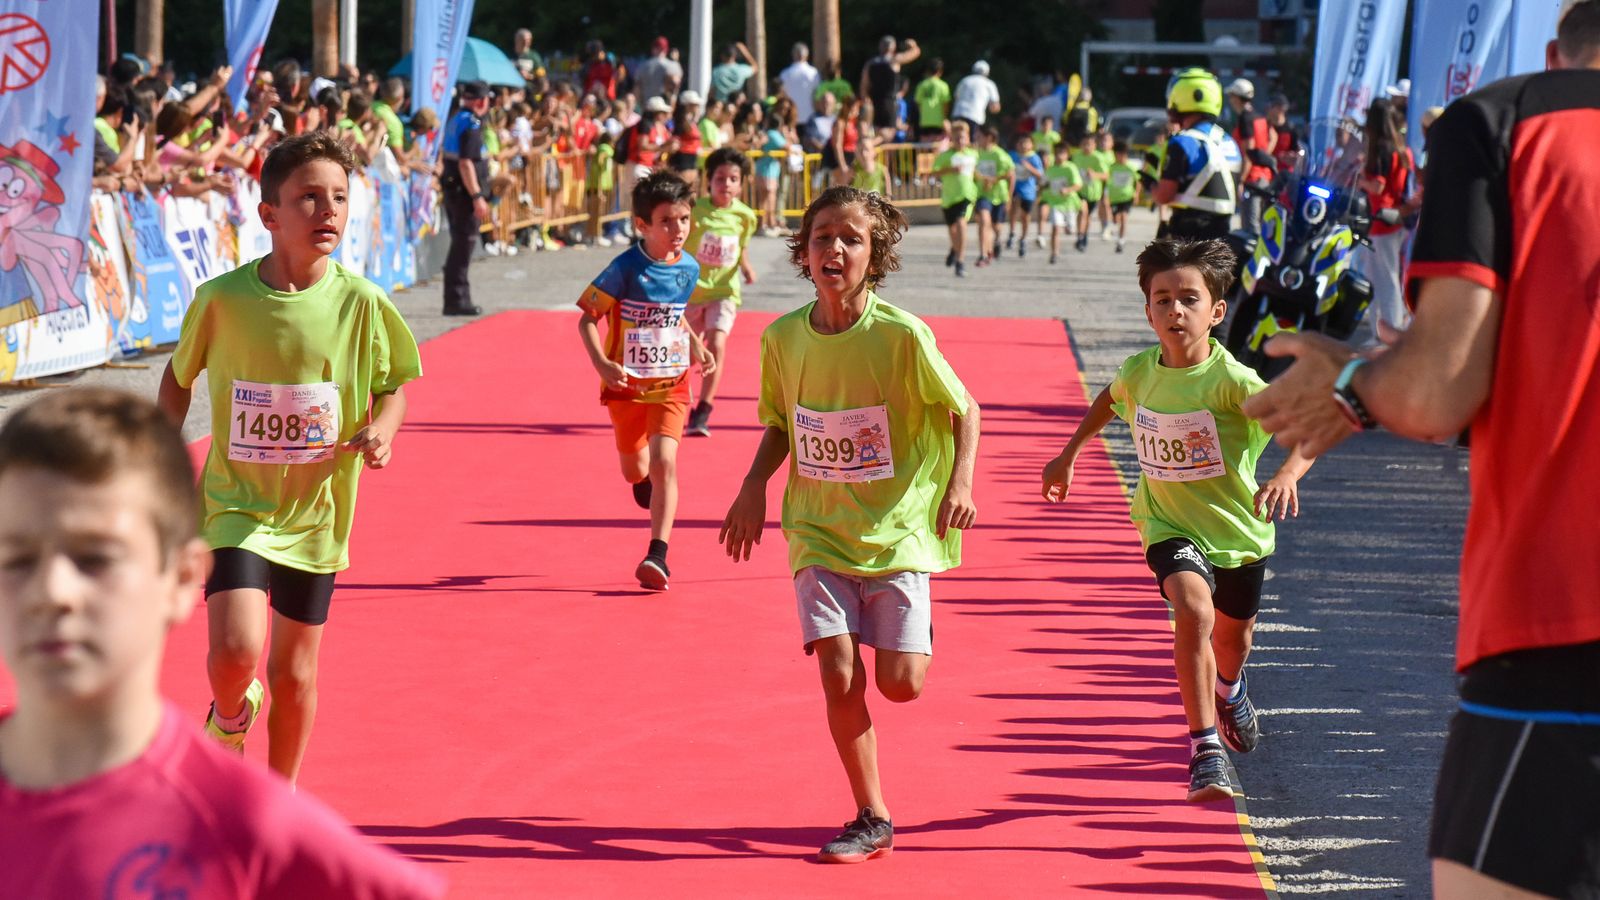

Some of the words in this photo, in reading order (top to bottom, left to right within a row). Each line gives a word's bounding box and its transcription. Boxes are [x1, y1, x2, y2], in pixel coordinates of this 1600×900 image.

[1348, 0, 1376, 78] Serg
[629, 346, 668, 364] 1533
[235, 387, 252, 402] XXI
[236, 410, 301, 442] 1498
[796, 412, 809, 427] XXI
[842, 413, 866, 422] JAVIER
[799, 433, 855, 464] 1399
[1139, 432, 1187, 463] 1138
[1173, 553, 1209, 574] adidas
